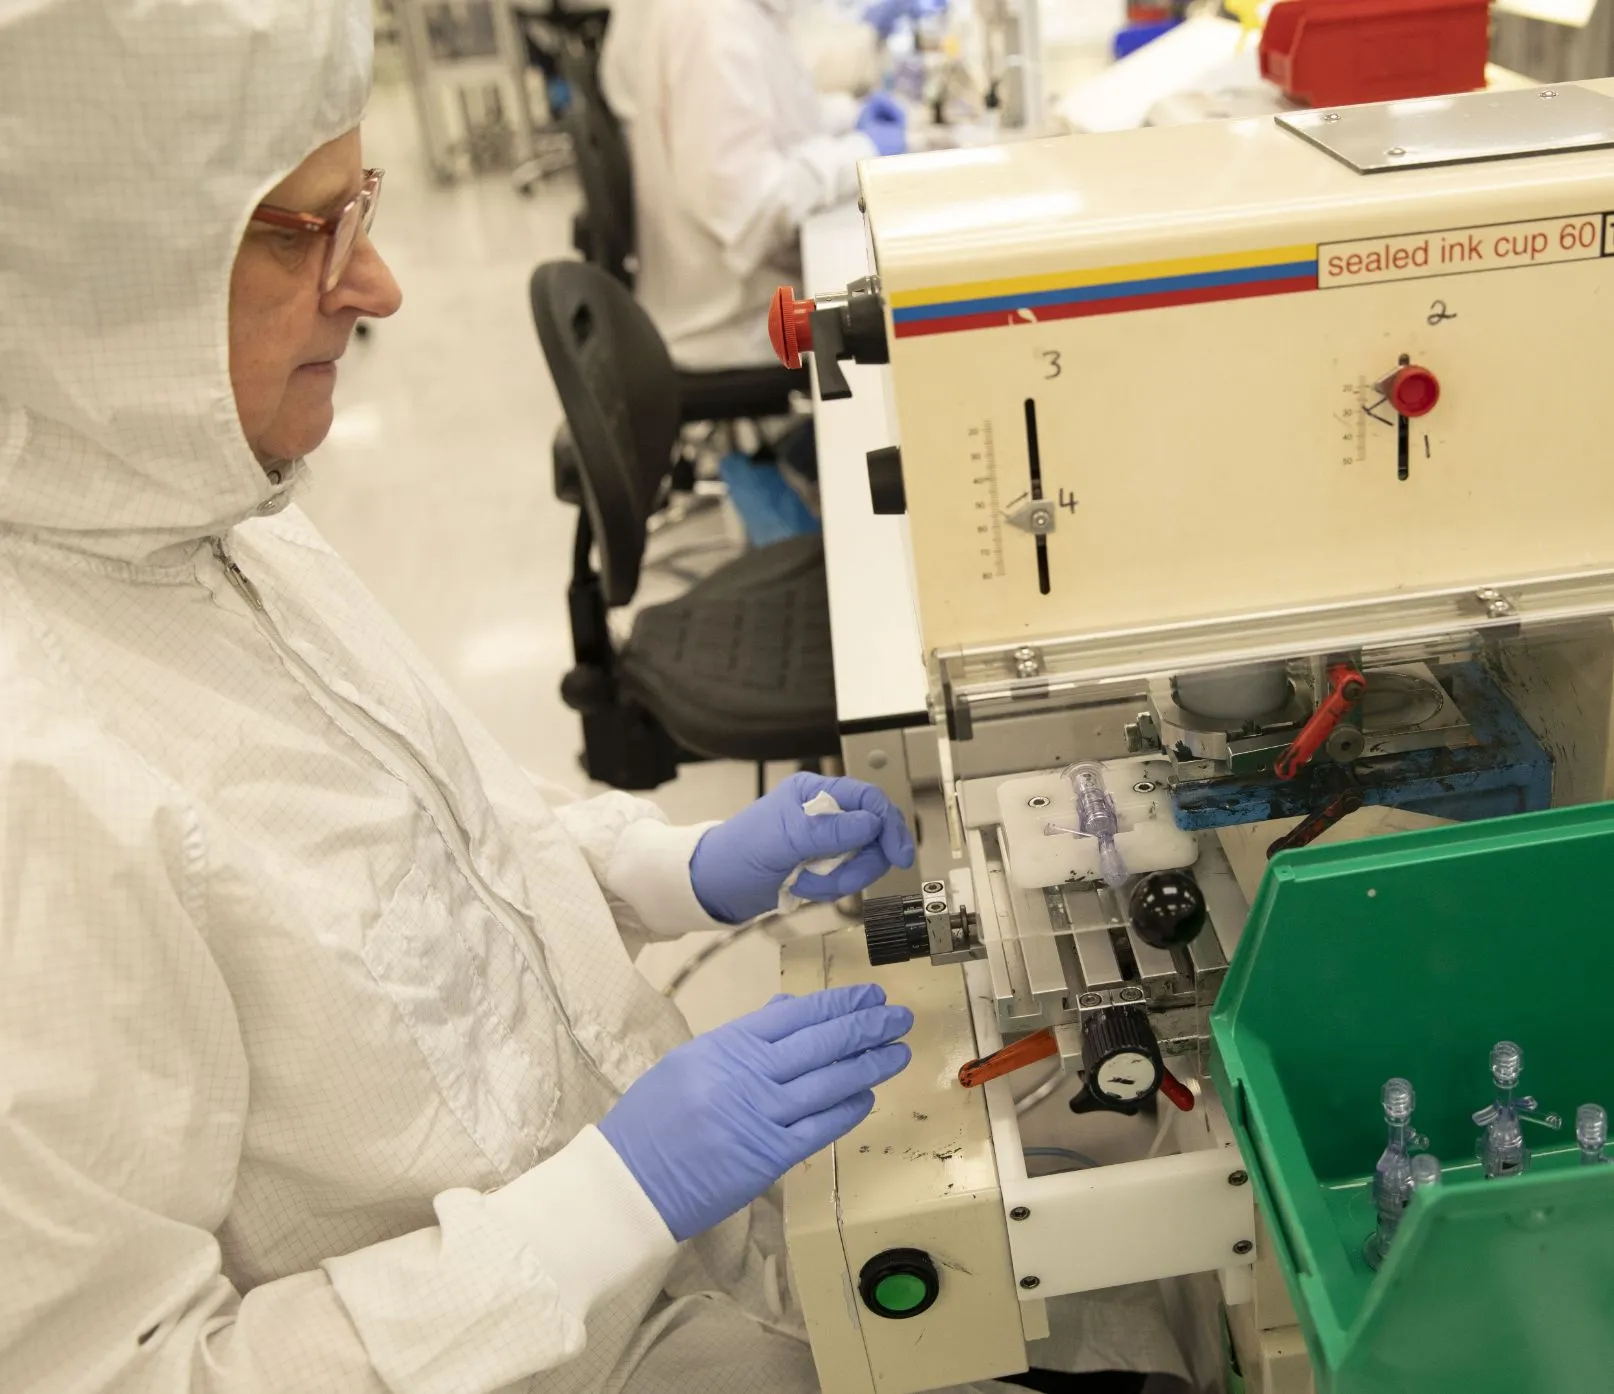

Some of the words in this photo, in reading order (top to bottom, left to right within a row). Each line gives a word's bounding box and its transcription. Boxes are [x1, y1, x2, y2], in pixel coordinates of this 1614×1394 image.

[1328, 240, 1429, 277] sealed
[1441, 234, 1483, 264] ink
[1494, 232, 1548, 261] cup
[1559, 221, 1596, 250] 60
[1427, 299, 1457, 326] 2
[1042, 350, 1061, 380] 3
[1059, 487, 1079, 515] 4
